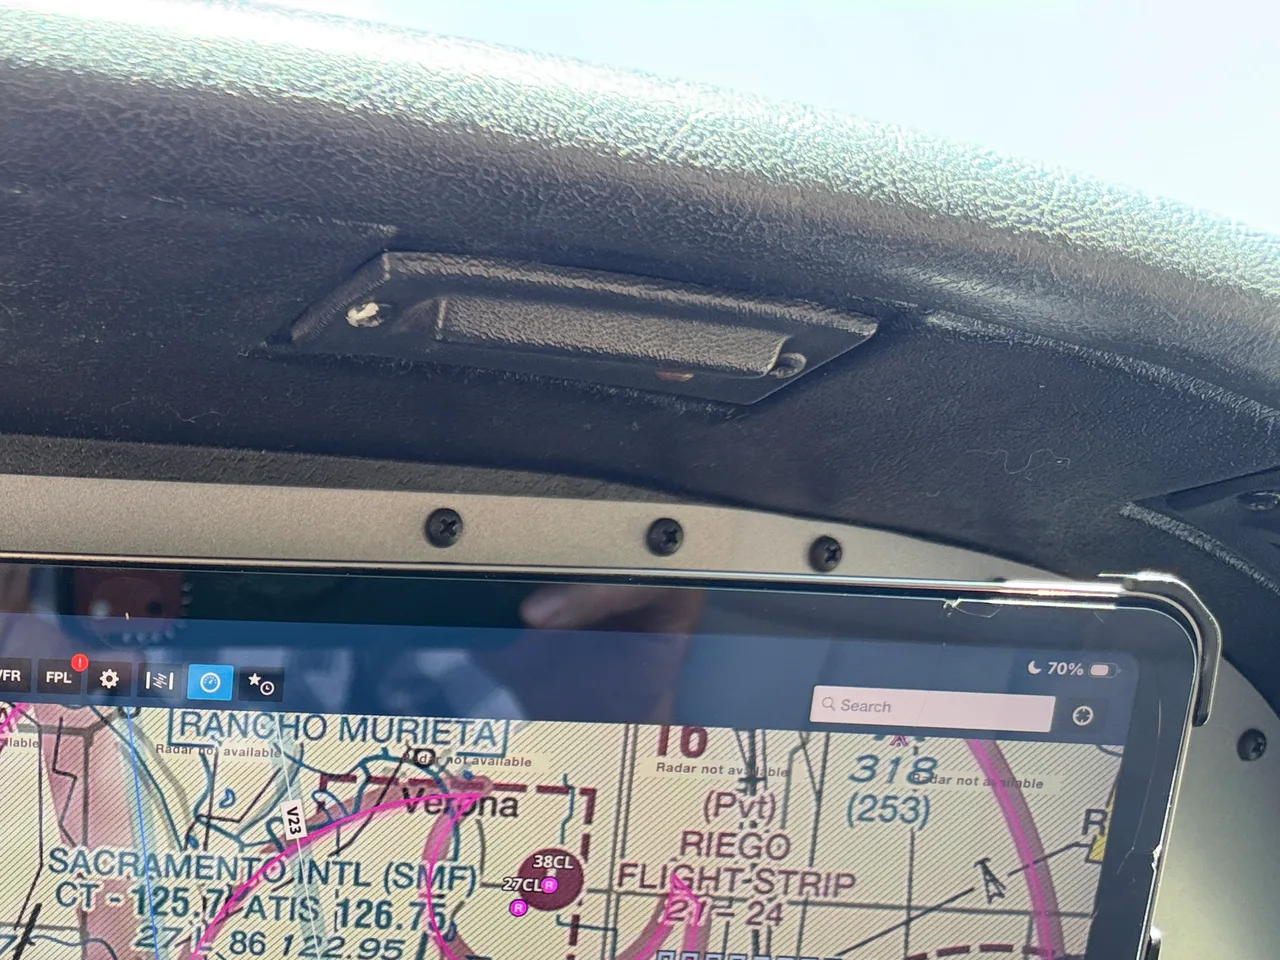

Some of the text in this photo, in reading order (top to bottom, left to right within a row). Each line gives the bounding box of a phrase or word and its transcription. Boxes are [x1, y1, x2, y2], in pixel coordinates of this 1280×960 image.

[1047, 661, 1084, 676] 70%
[45, 670, 72, 685] FPL
[841, 699, 892, 714] Search
[179, 709, 497, 747] RANCHO MURIETA
[403, 787, 519, 818] Verona
[845, 793, 930, 829] (253)
[680, 831, 791, 861] RIEGO
[533, 855, 573, 869] 38CL
[502, 877, 542, 892] 27CL
